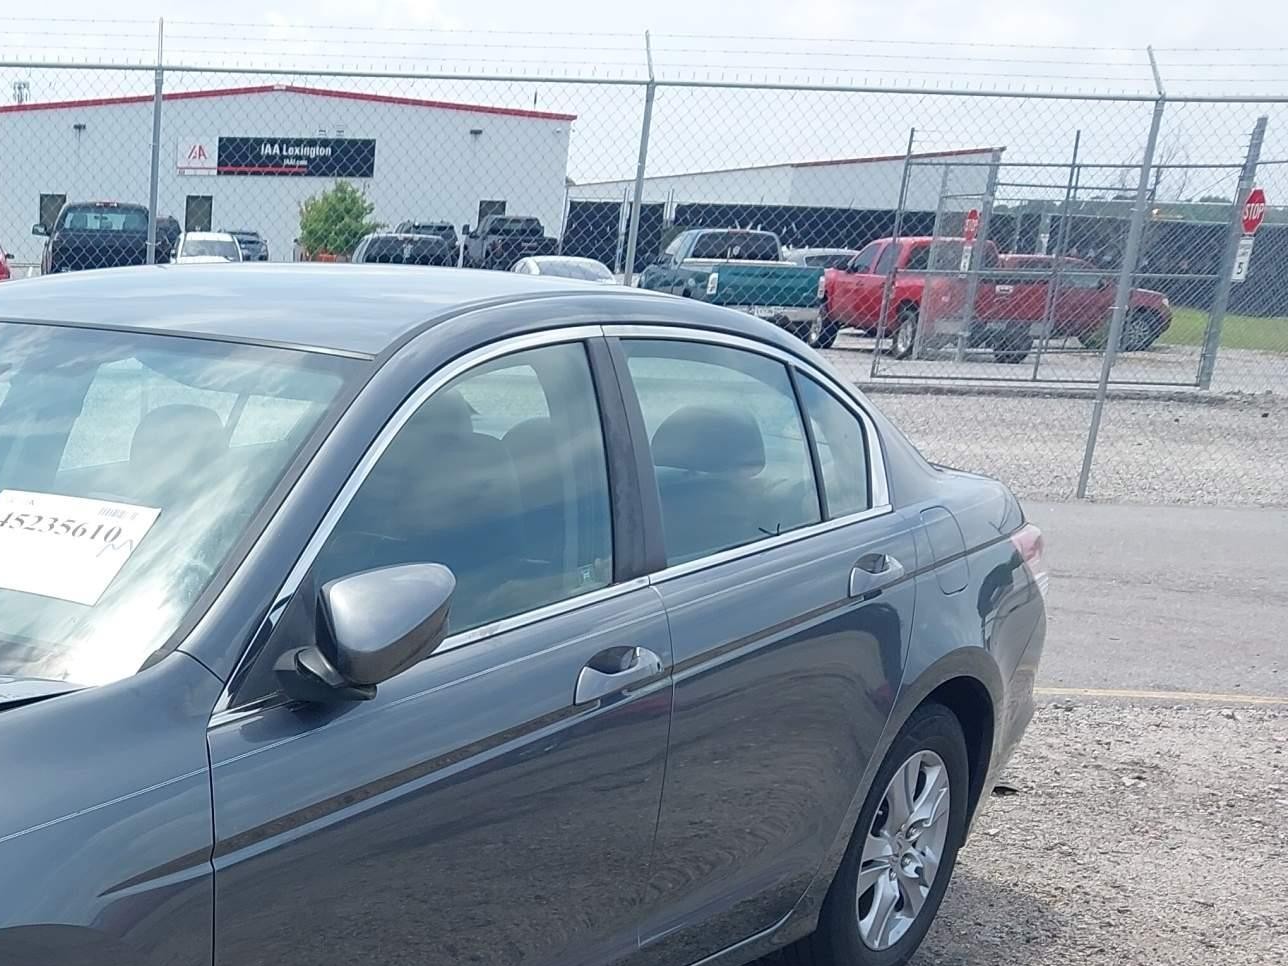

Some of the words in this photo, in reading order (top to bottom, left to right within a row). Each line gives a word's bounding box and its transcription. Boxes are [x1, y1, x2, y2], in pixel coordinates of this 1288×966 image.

[262, 144, 281, 155] IAA
[283, 144, 331, 158] Lexington
[1243, 203, 1264, 220] STOP
[1236, 261, 1245, 275] 5
